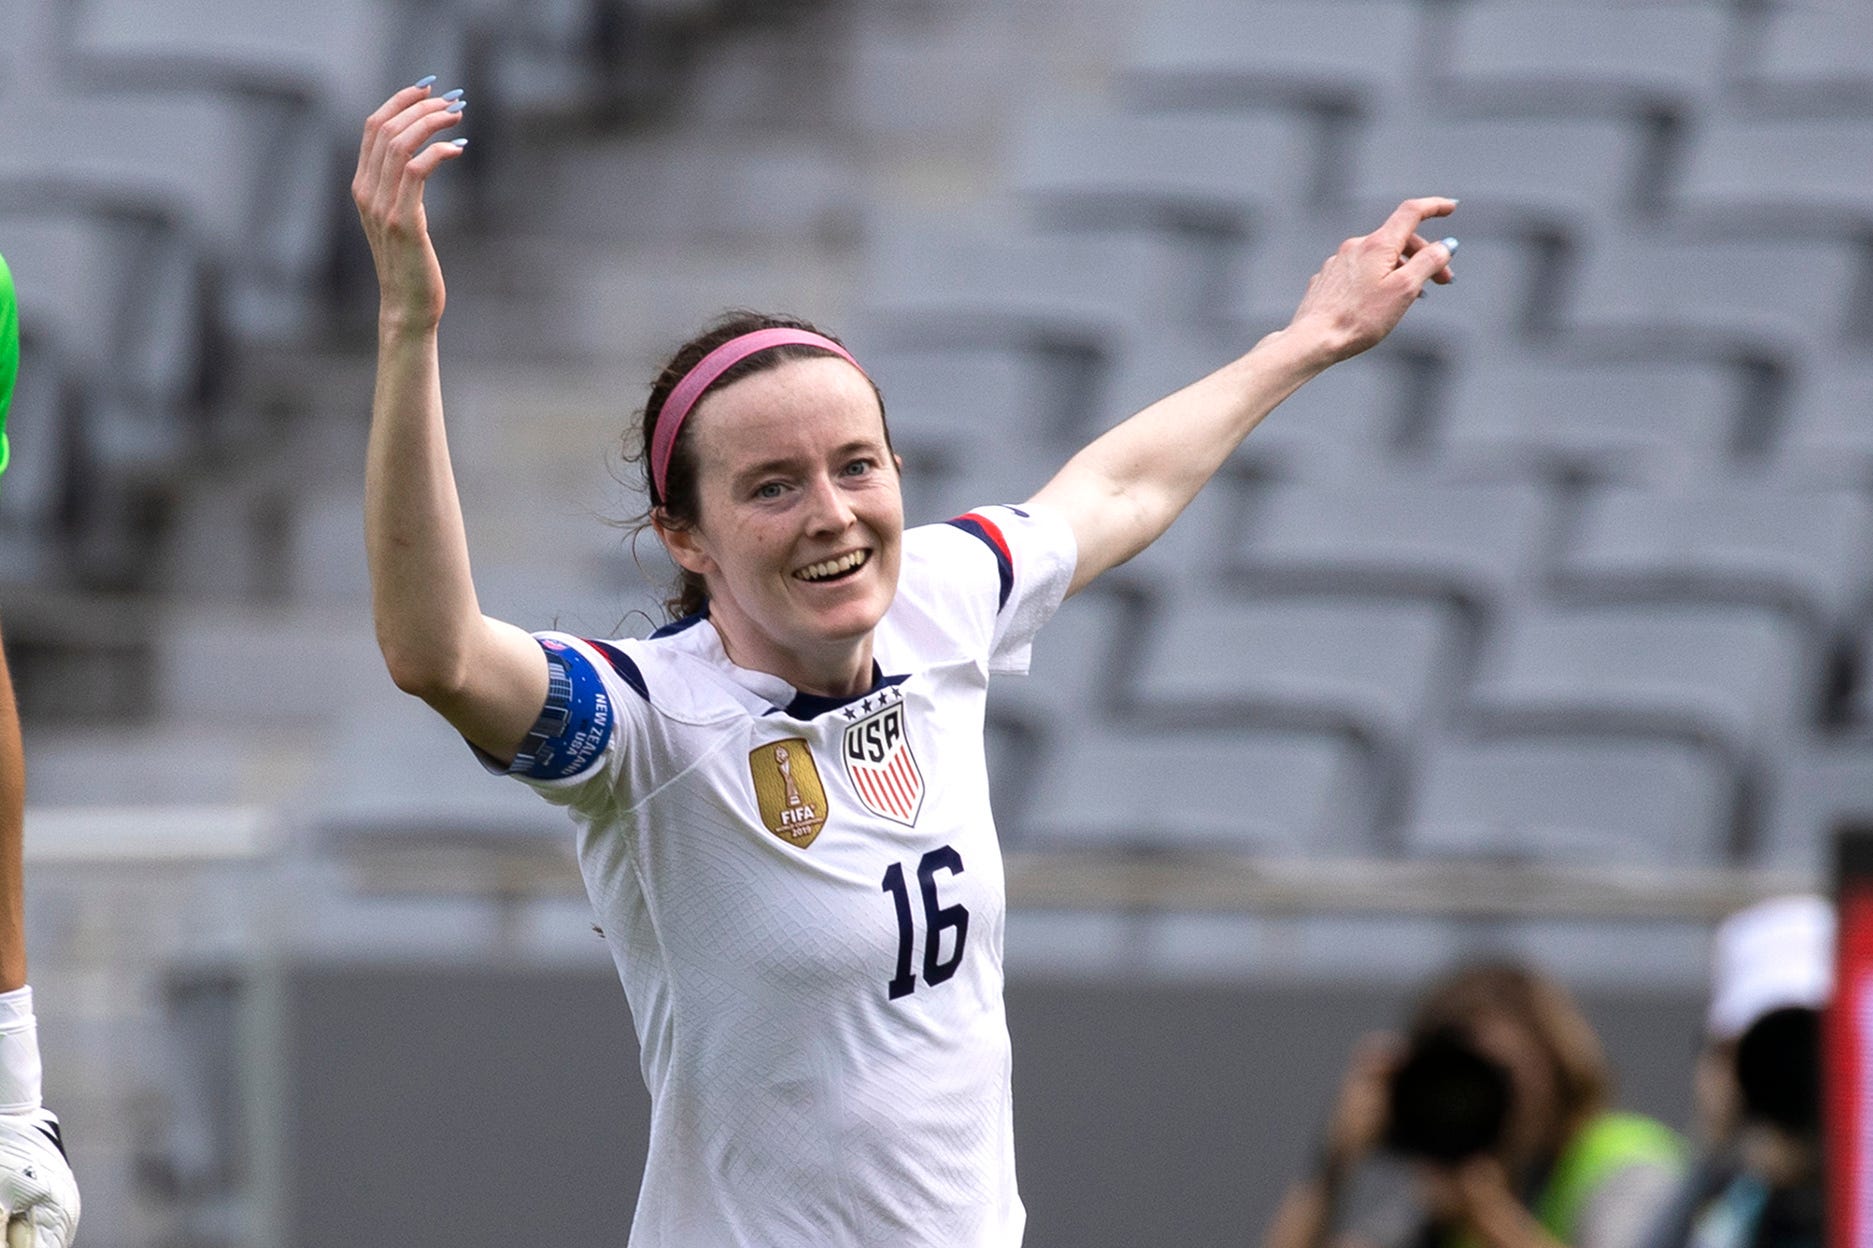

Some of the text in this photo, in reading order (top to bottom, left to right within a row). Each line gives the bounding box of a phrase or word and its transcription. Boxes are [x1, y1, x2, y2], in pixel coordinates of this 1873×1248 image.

[593, 693, 608, 727] NEW
[848, 709, 900, 763] USA
[781, 805, 815, 825] FIFA
[882, 845, 969, 1000] 16
